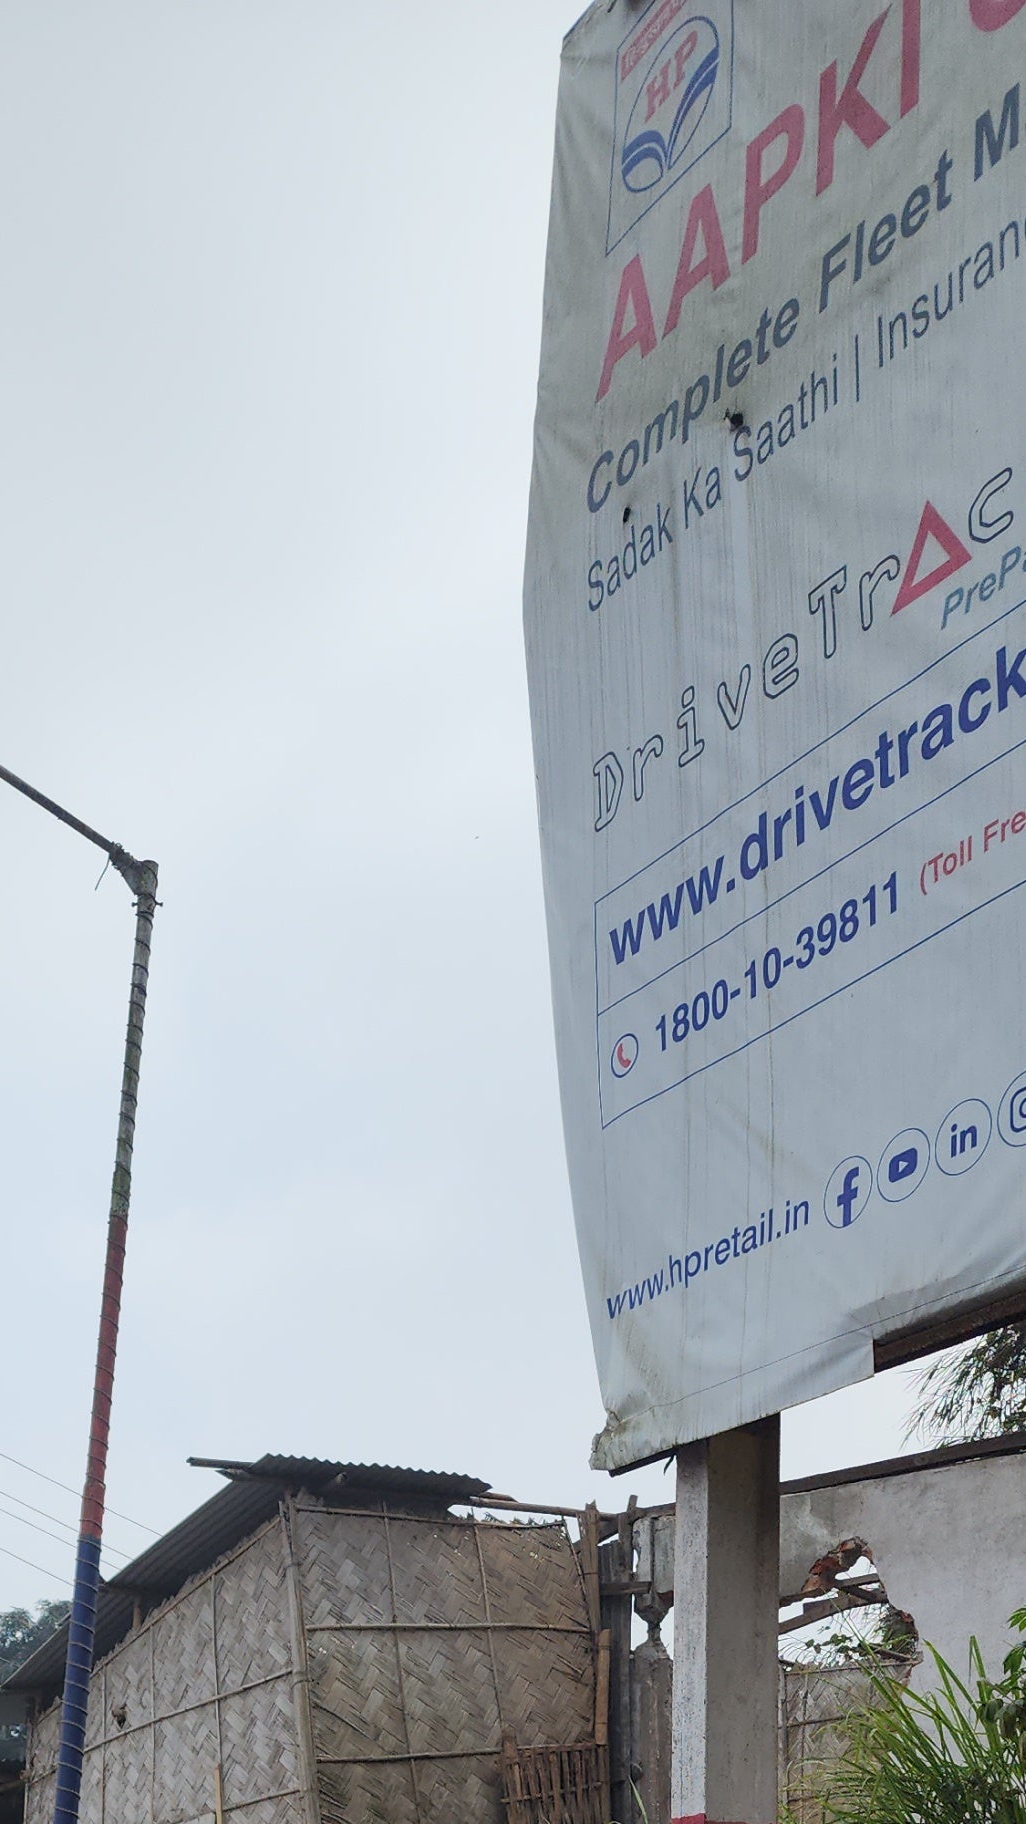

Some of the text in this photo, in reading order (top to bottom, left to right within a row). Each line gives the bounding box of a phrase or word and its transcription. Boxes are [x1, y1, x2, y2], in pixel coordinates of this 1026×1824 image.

[643, 29, 699, 124] HP
[595, 0, 921, 403] AAPKI
[586, 297, 801, 515] Complete
[817, 148, 953, 314] Fleet
[587, 503, 674, 611] Sadak
[683, 463, 722, 530] Ka
[733, 353, 838, 484] Saathi
[654, 869, 898, 1054] 1800-10-39811
[919, 834, 973, 897] (Toll
[606, 1198, 810, 1321] www.hpretail.in
